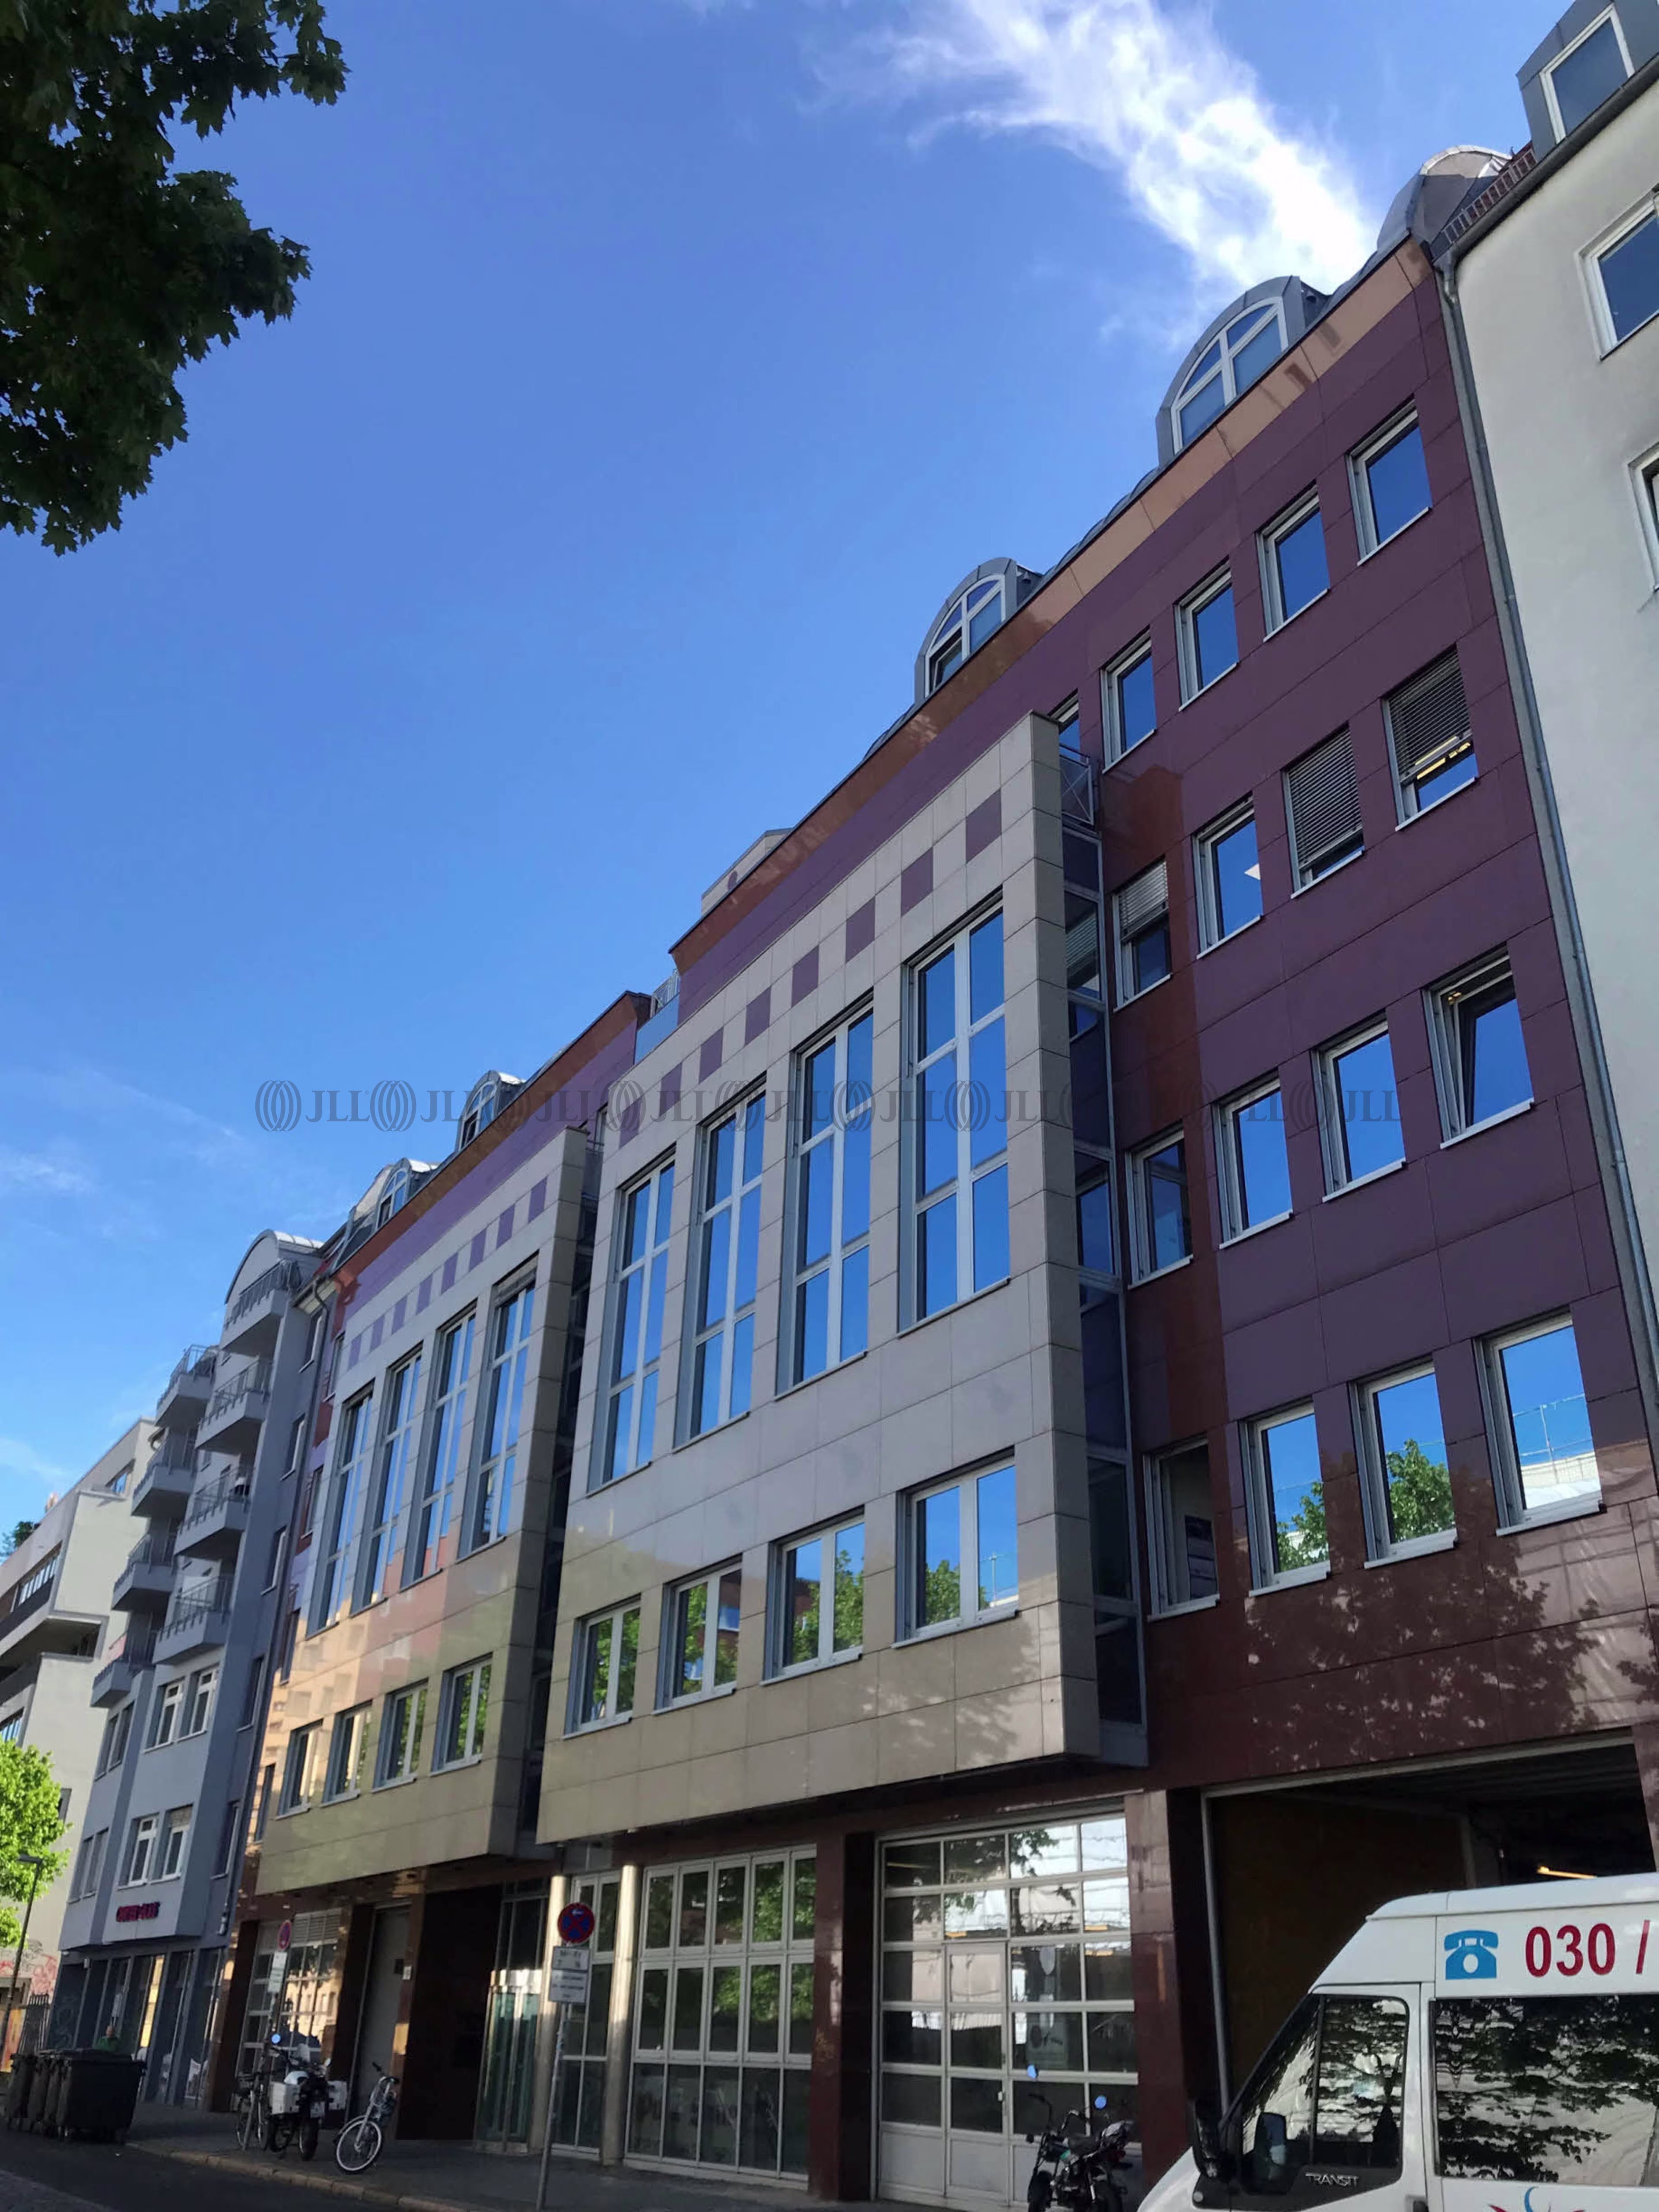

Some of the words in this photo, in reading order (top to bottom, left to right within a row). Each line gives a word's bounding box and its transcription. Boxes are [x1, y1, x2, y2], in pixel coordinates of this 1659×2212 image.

[1526, 1923, 1615, 1977] 030
[1636, 1920, 1650, 1974] /
[1305, 2173, 1359, 2187] TRANSIT
